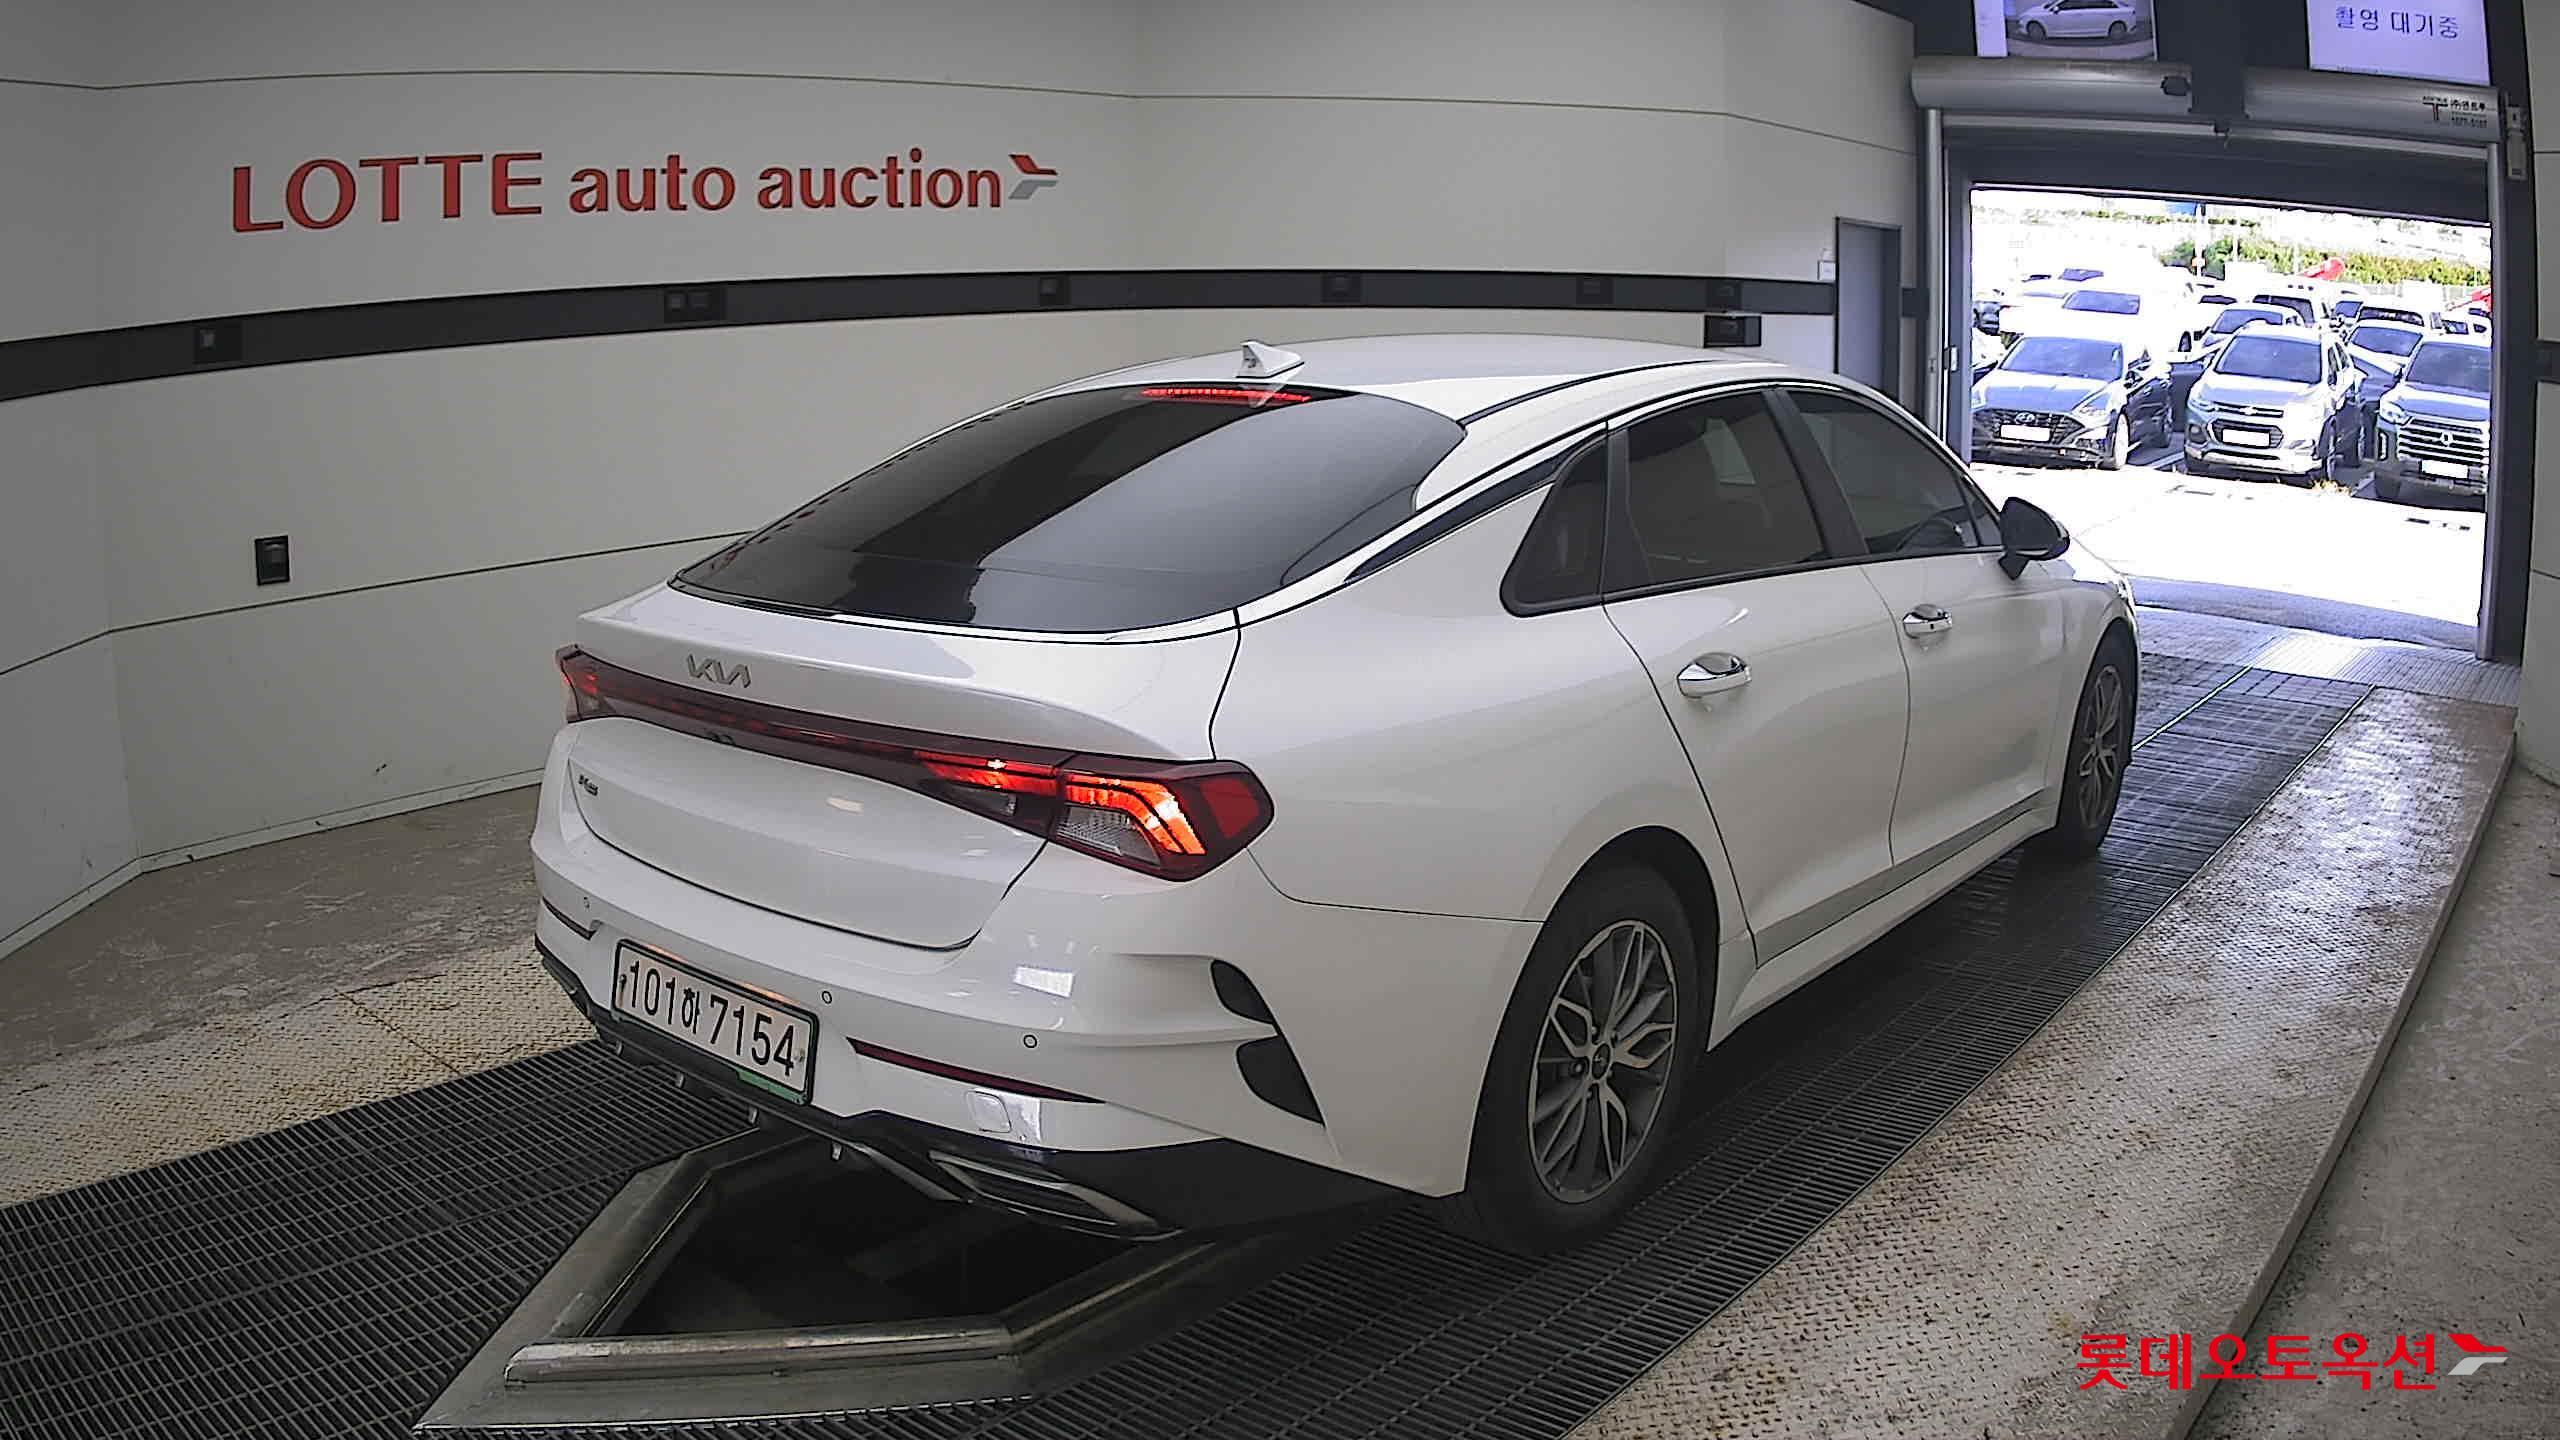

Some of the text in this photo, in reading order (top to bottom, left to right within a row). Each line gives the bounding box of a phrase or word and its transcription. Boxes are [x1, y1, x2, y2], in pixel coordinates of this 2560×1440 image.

[2390, 11, 2458, 39] 대기중
[232, 147, 1002, 233] LOTTE auto auction
[686, 653, 752, 689] KIA
